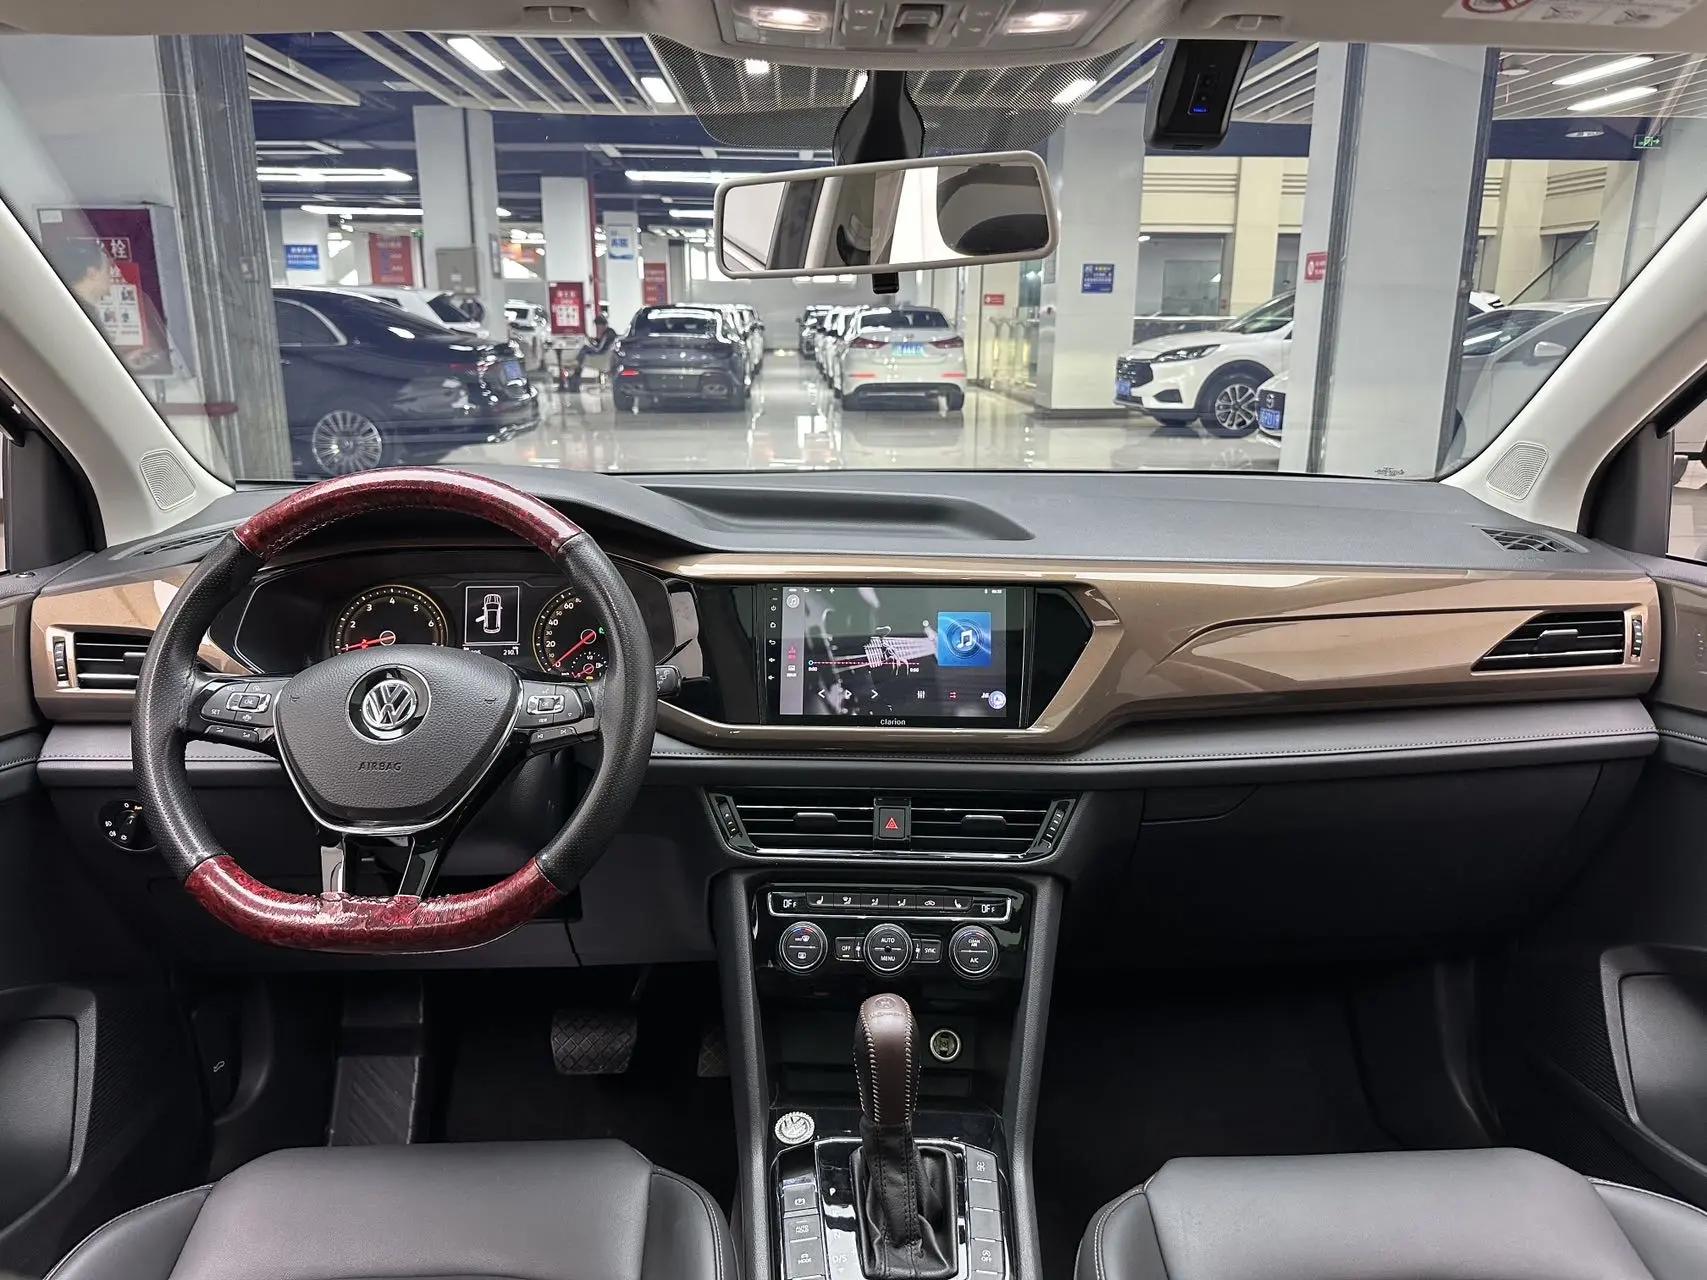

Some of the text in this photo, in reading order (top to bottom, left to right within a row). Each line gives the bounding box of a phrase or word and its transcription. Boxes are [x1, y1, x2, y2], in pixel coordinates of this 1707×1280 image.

[413, 604, 419, 612] 5
[350, 620, 356, 628] 2
[545, 640, 556, 648] 20
[358, 761, 402, 771] AIRBAG
[832, 1254, 848, 1263] D/S
